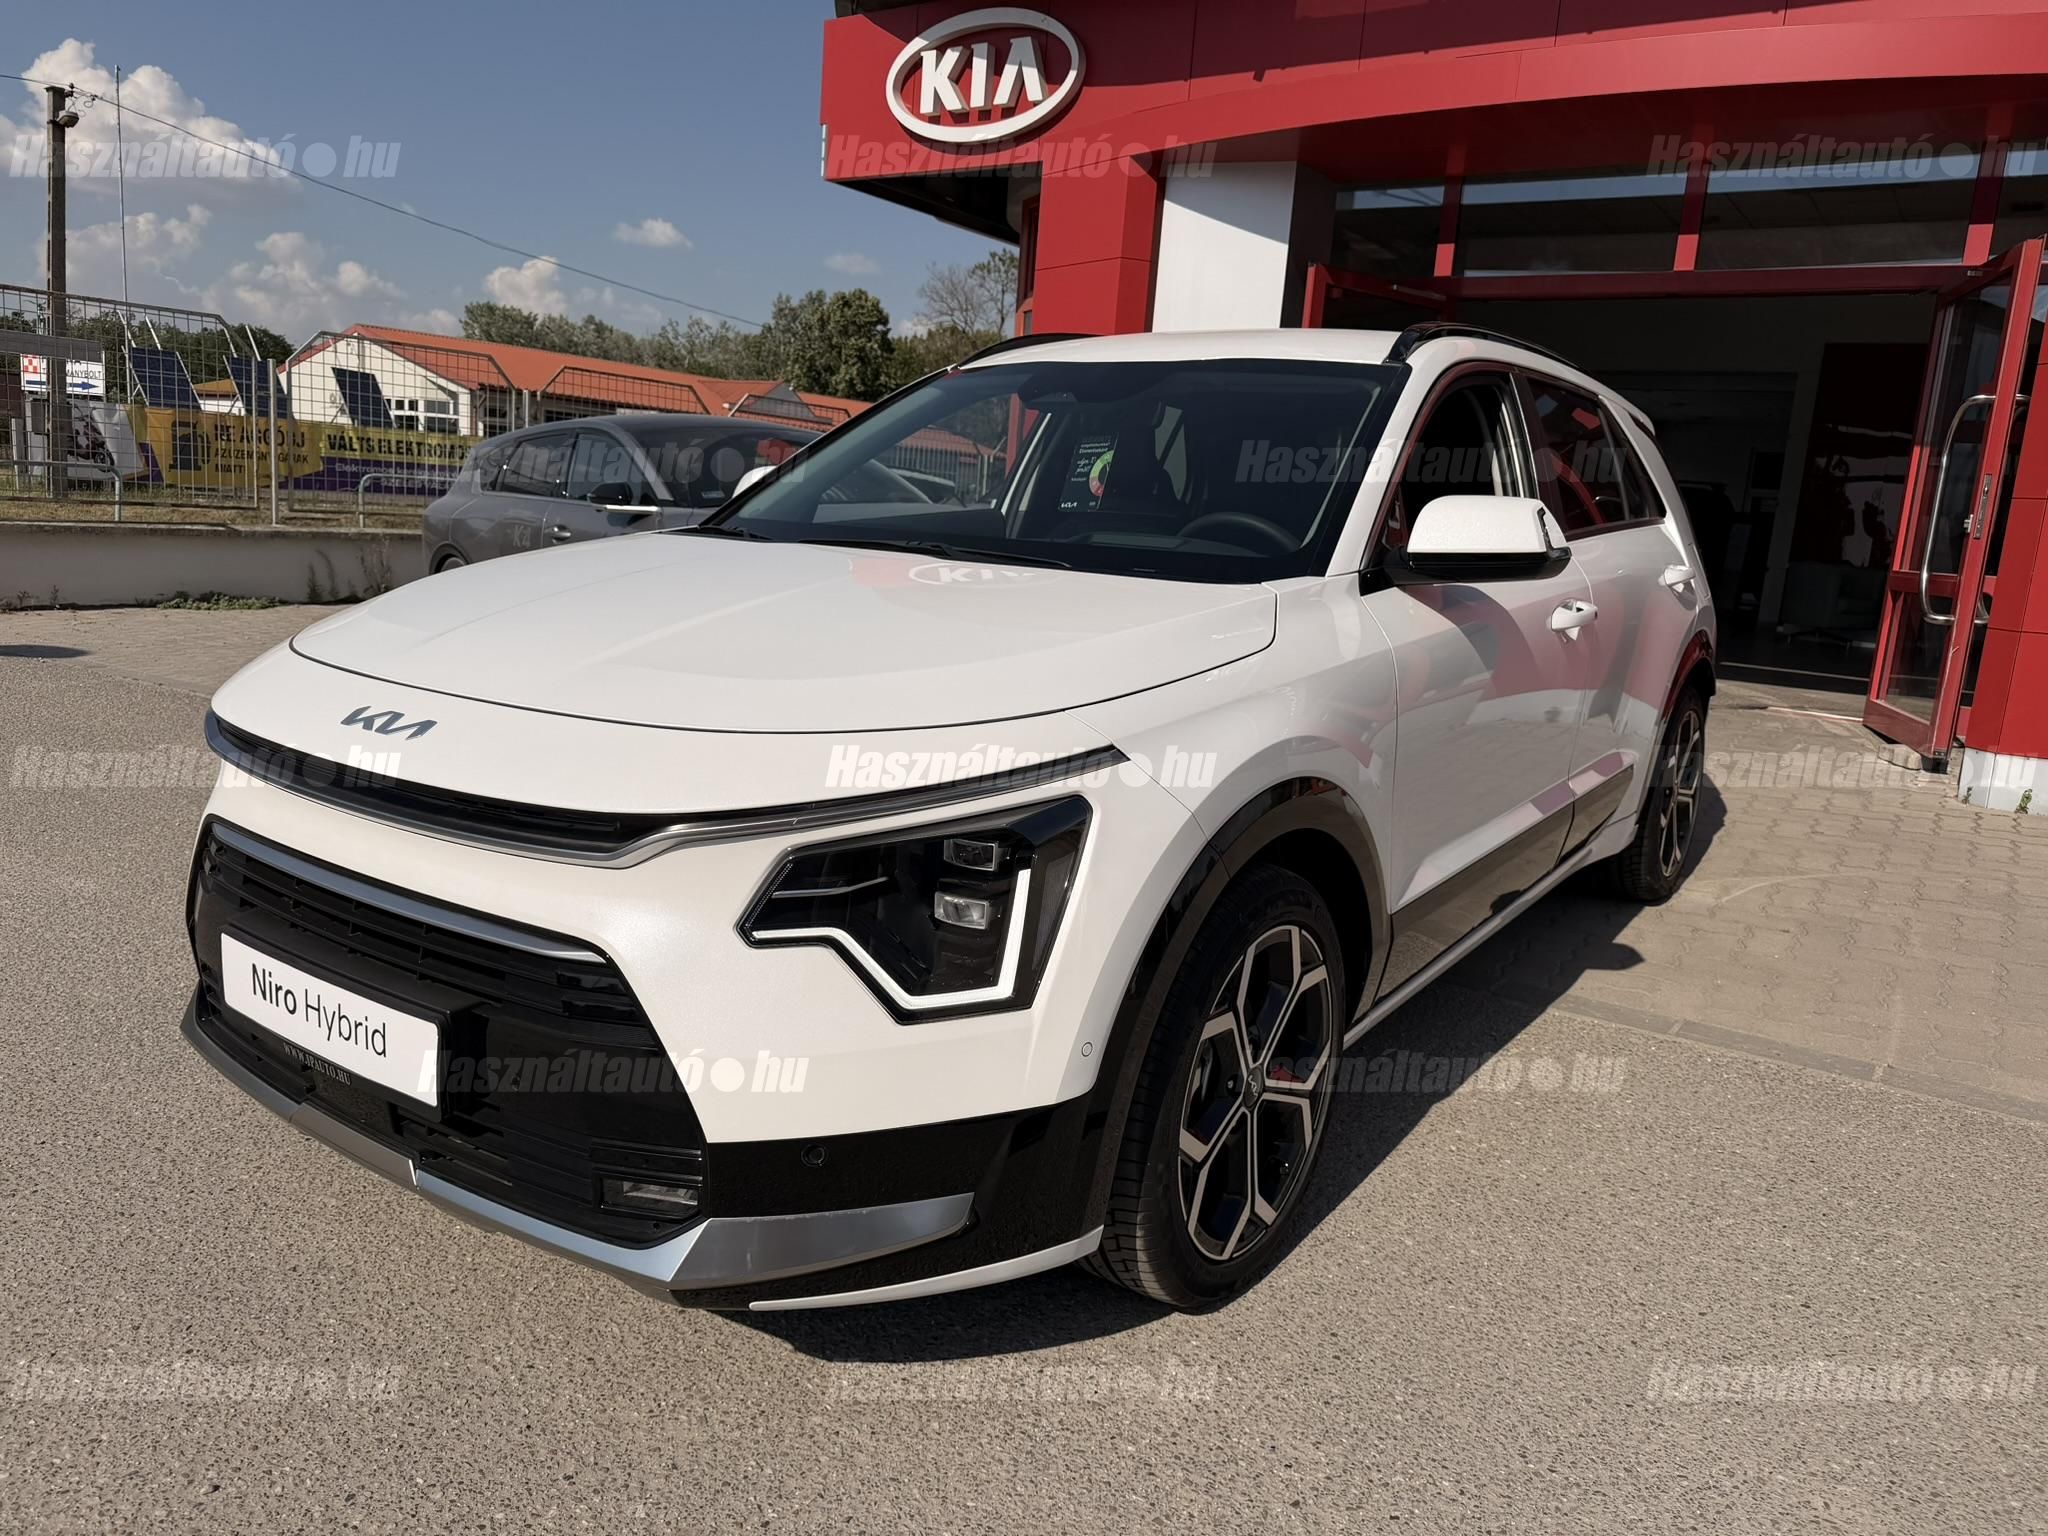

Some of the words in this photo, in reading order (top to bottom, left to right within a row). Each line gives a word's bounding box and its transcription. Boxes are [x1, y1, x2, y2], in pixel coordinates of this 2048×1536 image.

[919, 36, 1047, 116] KIA
[327, 430, 375, 454] VÁLTS
[340, 705, 438, 740] KIA
[252, 962, 297, 1015] Niro
[305, 988, 387, 1058] Hybrid
